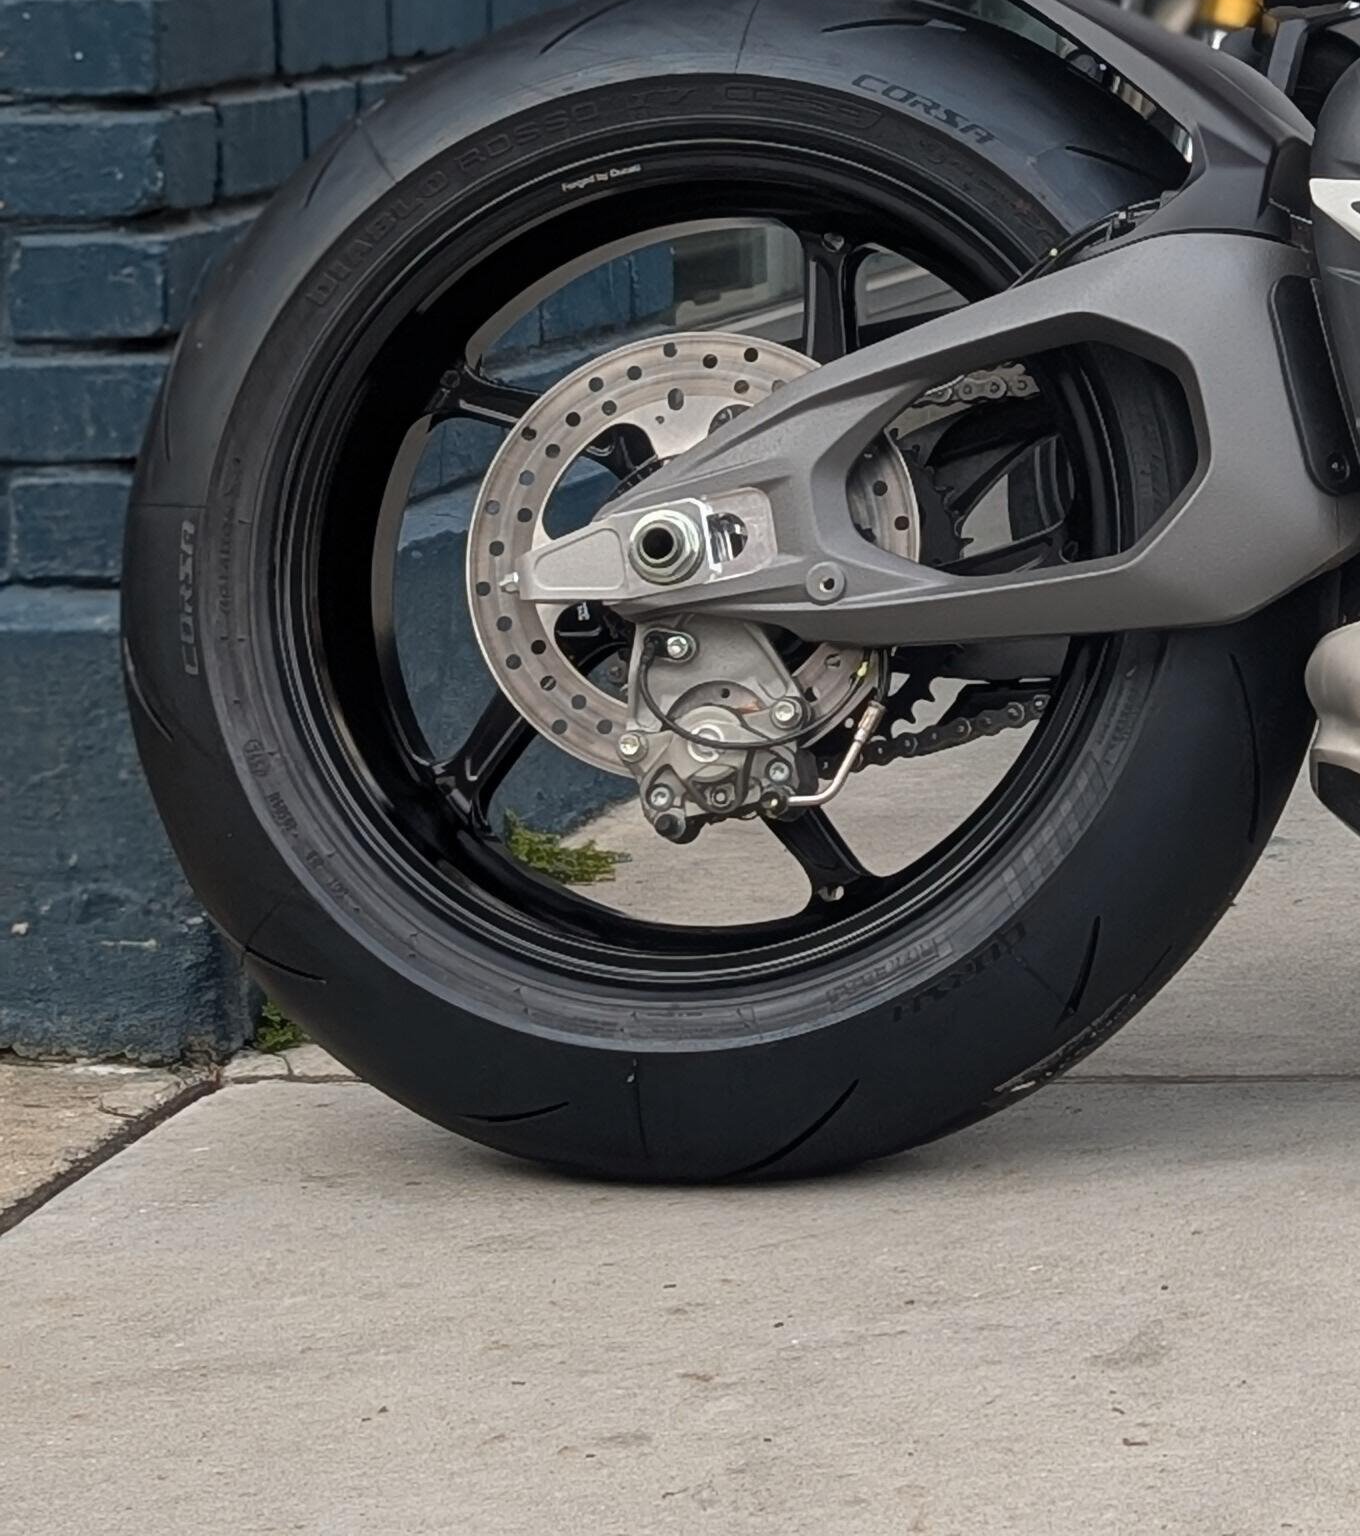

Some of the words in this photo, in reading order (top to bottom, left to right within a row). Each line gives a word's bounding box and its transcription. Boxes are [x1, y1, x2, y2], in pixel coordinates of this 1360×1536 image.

[851, 73, 998, 145] CORSA
[305, 169, 449, 307] DIABLO
[453, 100, 599, 174] ROSSO
[178, 520, 199, 676] CORSA
